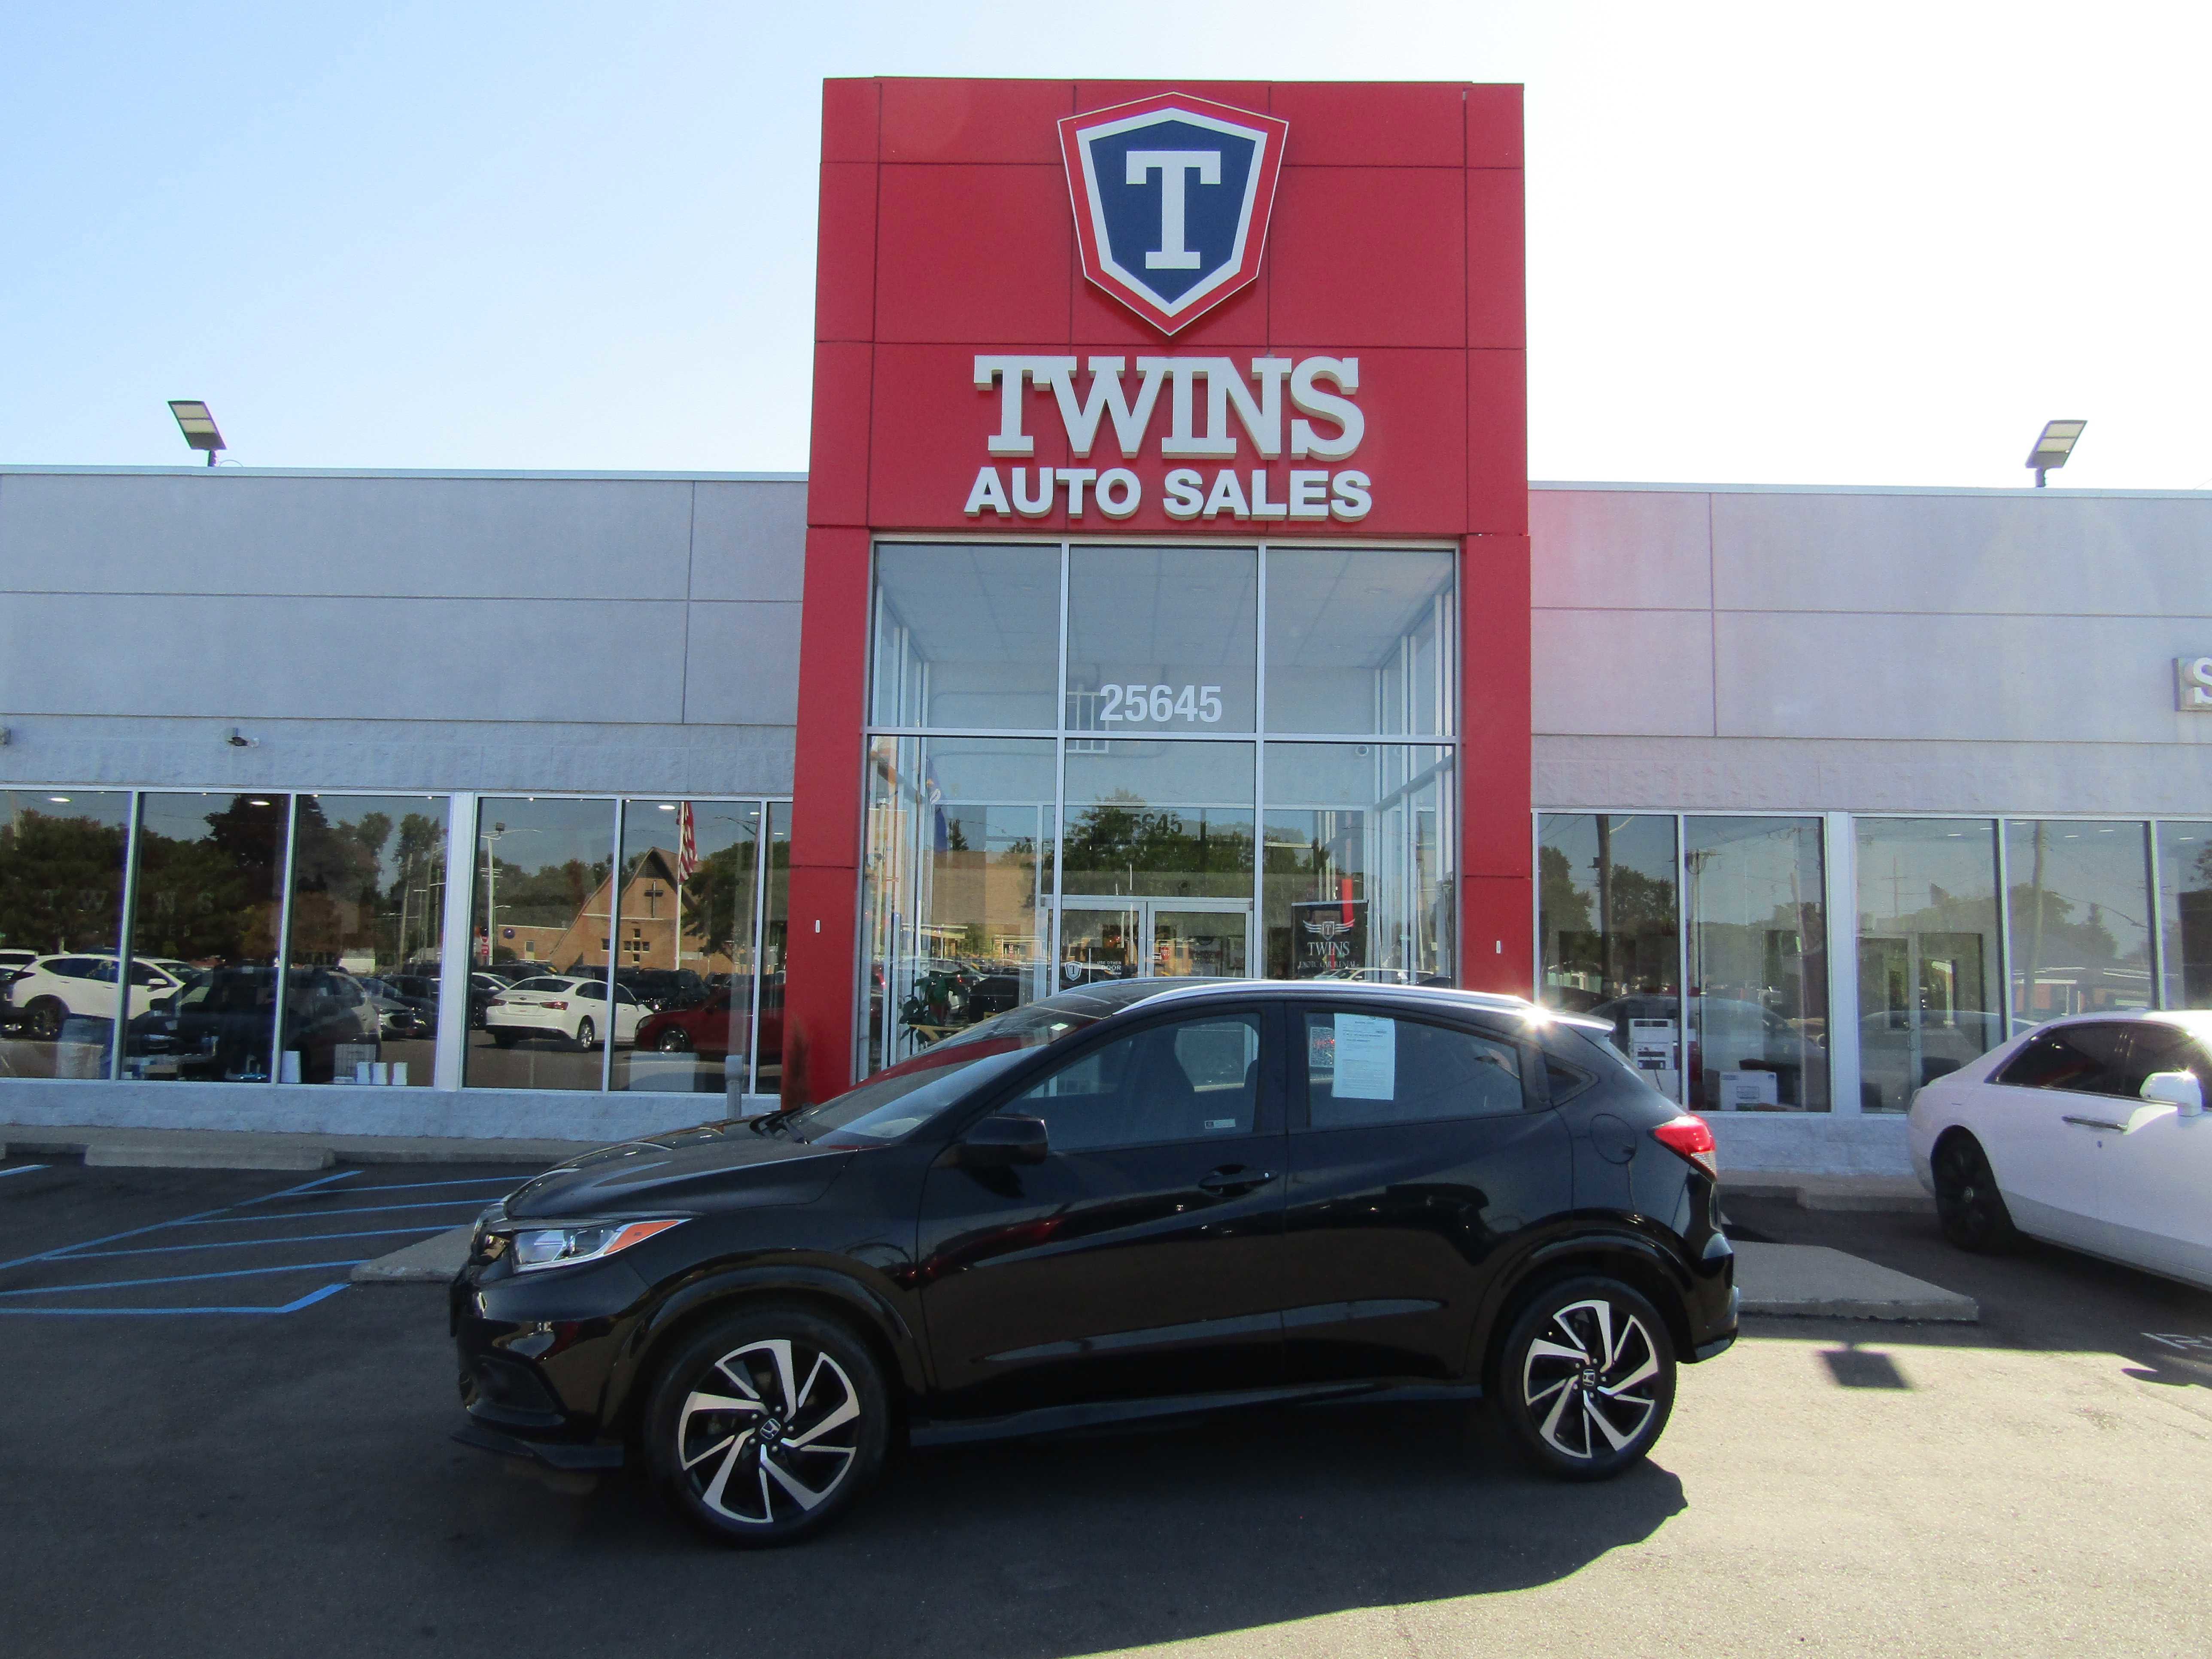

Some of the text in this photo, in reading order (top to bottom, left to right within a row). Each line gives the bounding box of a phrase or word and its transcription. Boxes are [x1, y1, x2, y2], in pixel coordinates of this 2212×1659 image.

[1126, 150, 1221, 270] T
[974, 355, 1365, 462] TWINS
[963, 466, 1372, 522] AUTO SALES
[1100, 684, 1222, 723] 25645
[1307, 941, 1350, 956] TWINS
